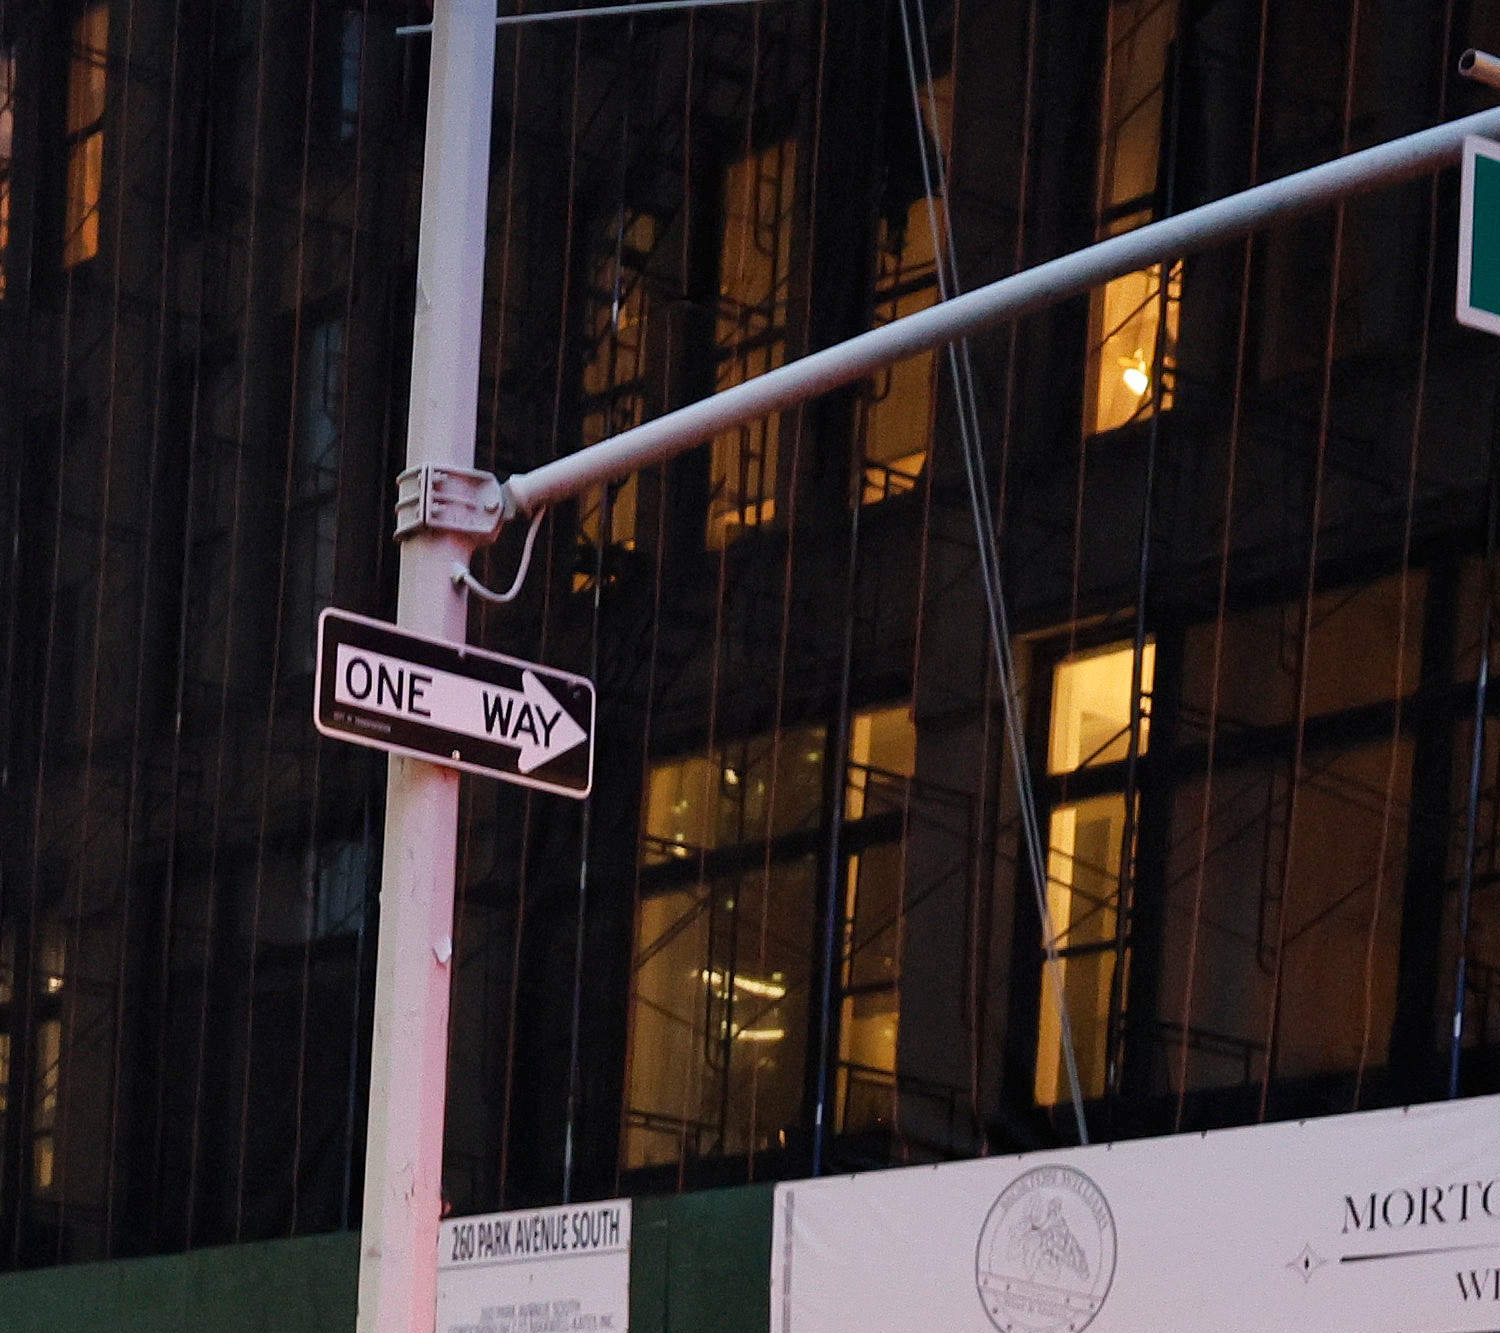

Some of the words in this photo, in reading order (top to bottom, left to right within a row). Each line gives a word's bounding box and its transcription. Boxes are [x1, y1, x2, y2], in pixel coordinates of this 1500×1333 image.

[345, 656, 433, 718] ONE
[482, 690, 563, 748] WAY
[451, 1223, 476, 1261] 260
[478, 1218, 513, 1258] PARK
[514, 1212, 568, 1253] AVENUE
[571, 1207, 621, 1249] SOUTH
